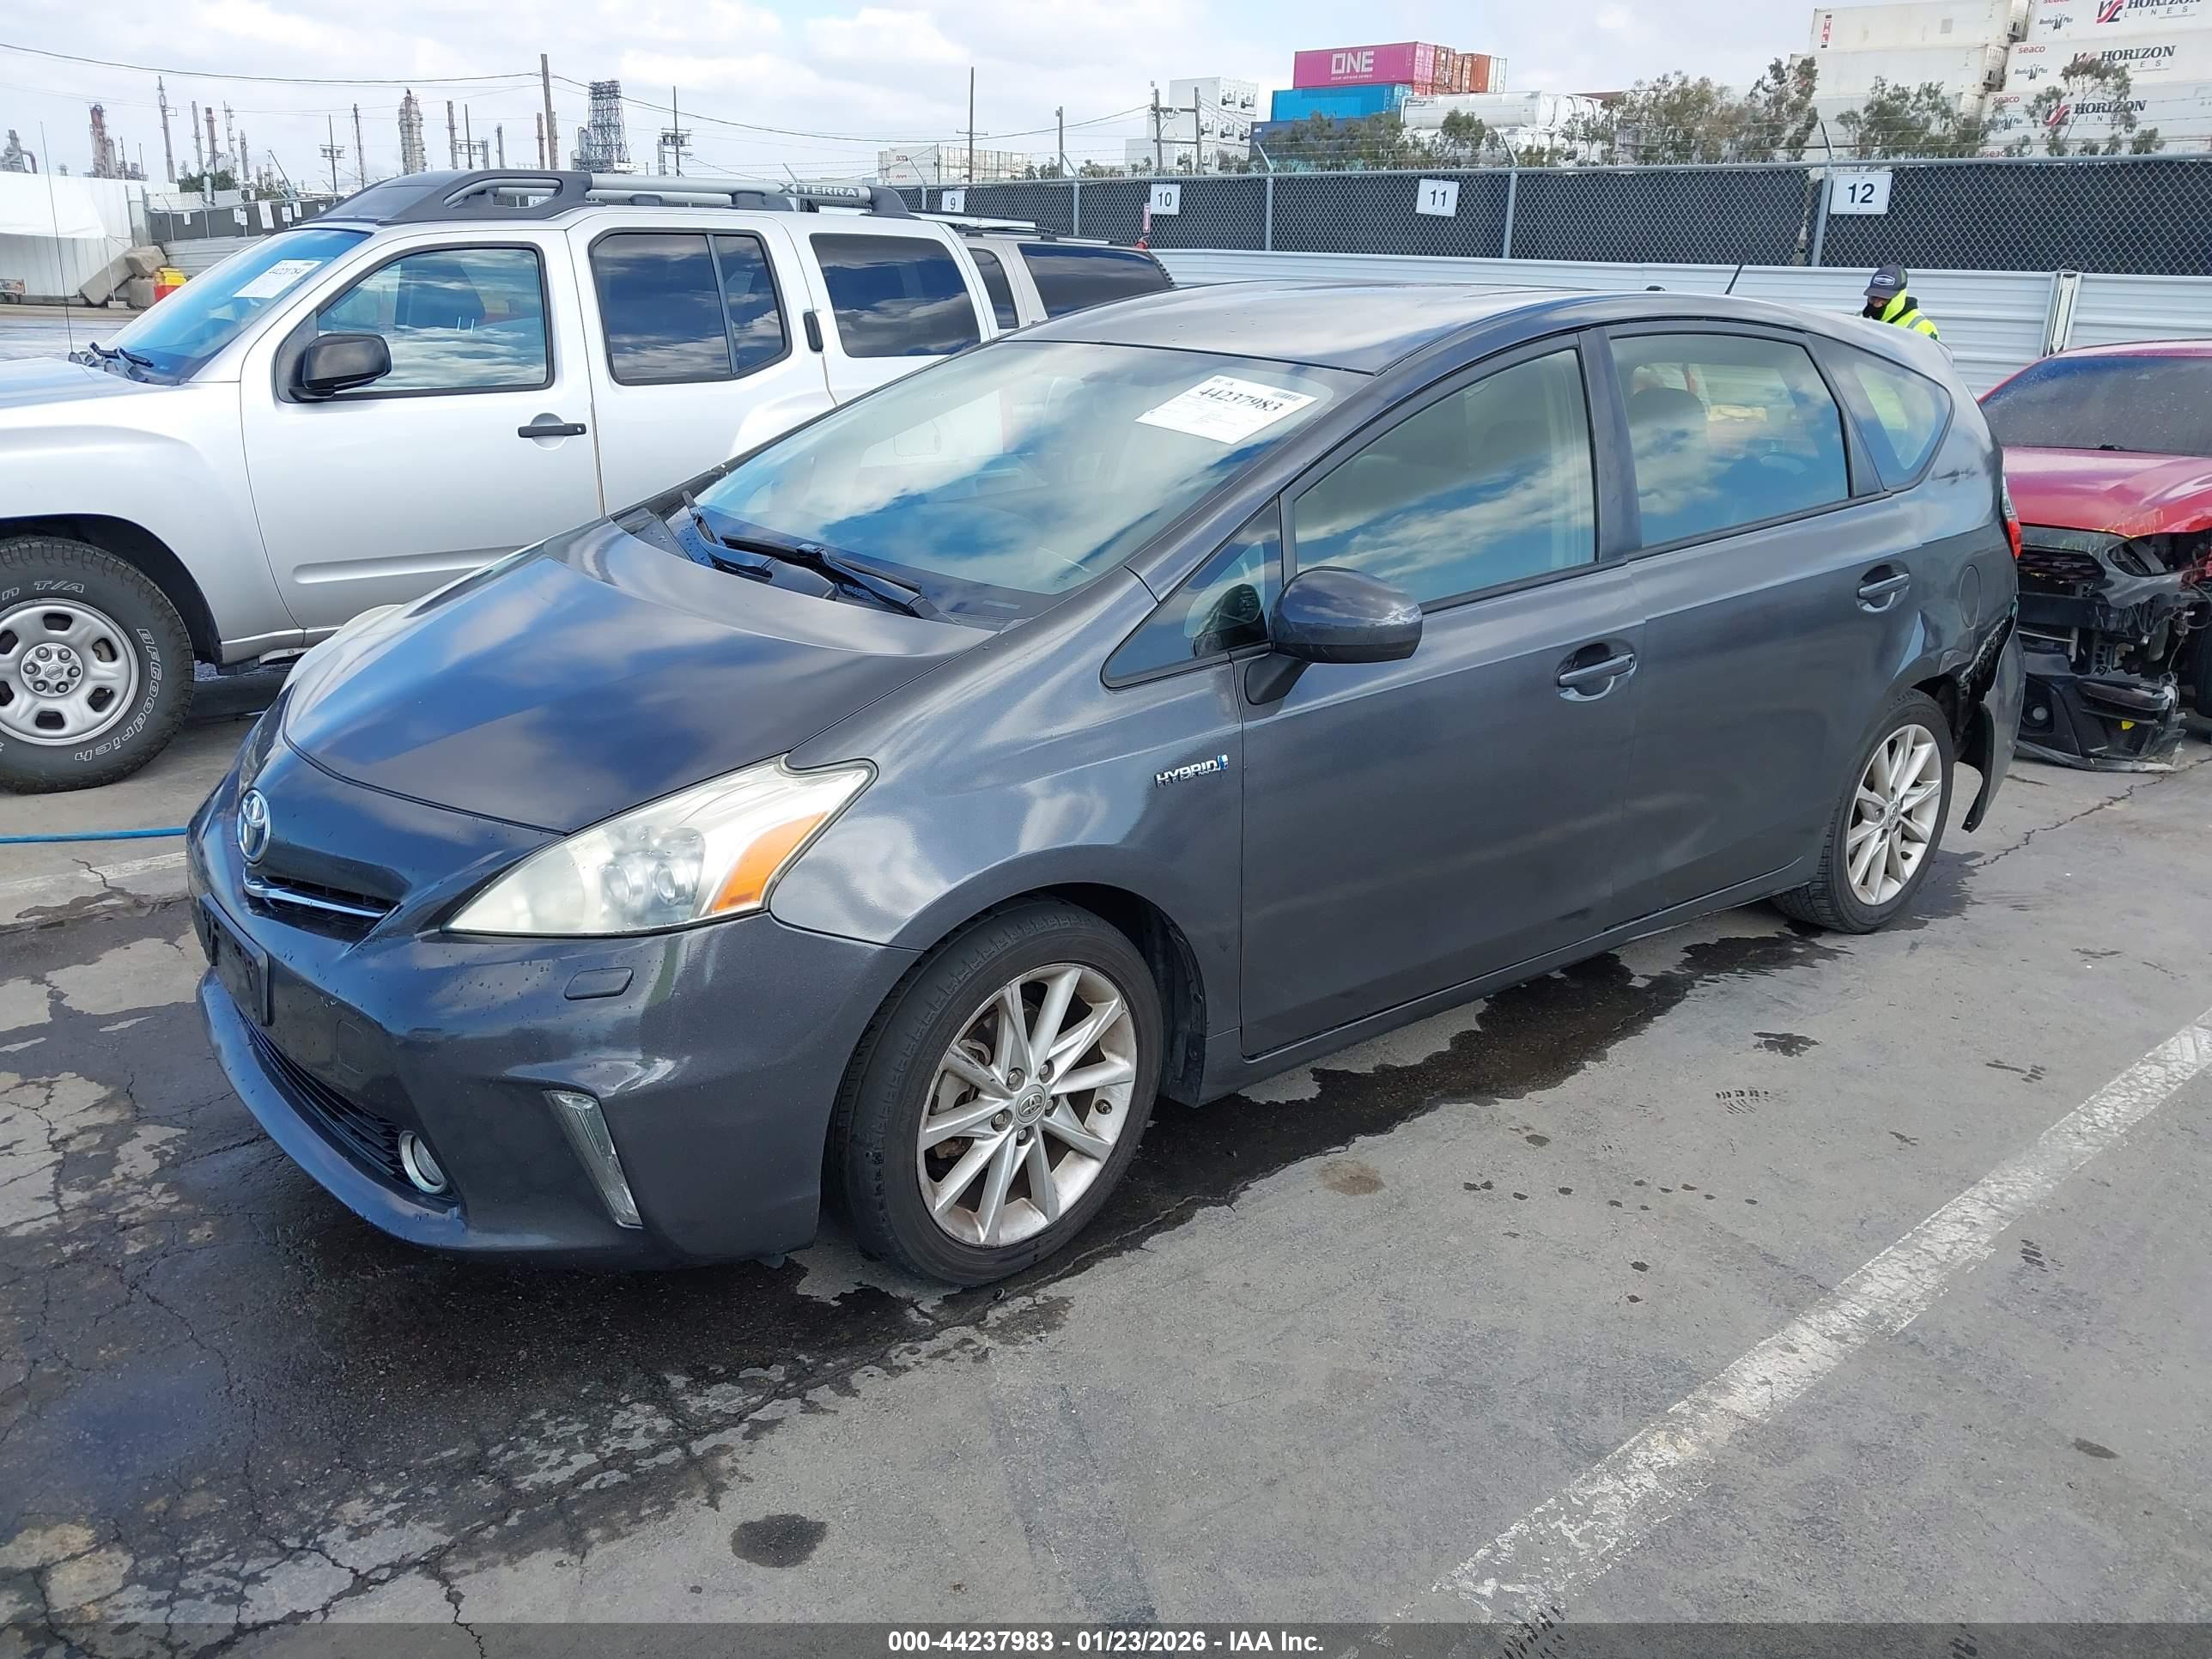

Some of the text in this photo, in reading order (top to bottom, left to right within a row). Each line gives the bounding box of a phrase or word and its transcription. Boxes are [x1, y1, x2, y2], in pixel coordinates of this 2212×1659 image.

[2124, 6, 2188, 18] LINES
[2018, 46, 2046, 54] seaco
[2100, 46, 2177, 62] HORIZON
[1331, 51, 1374, 75] ONE
[2073, 100, 2147, 114] HORIZON
[1158, 191, 1172, 207] 10
[1431, 189, 1447, 207] 11
[1848, 183, 1875, 204] 12
[950, 197, 956, 210] 9
[1199, 387, 1284, 412] 44237983
[34, 580, 85, 593] T/A
[75, 628, 163, 763] BFGoodrich
[1155, 759, 1220, 786] HYBRID
